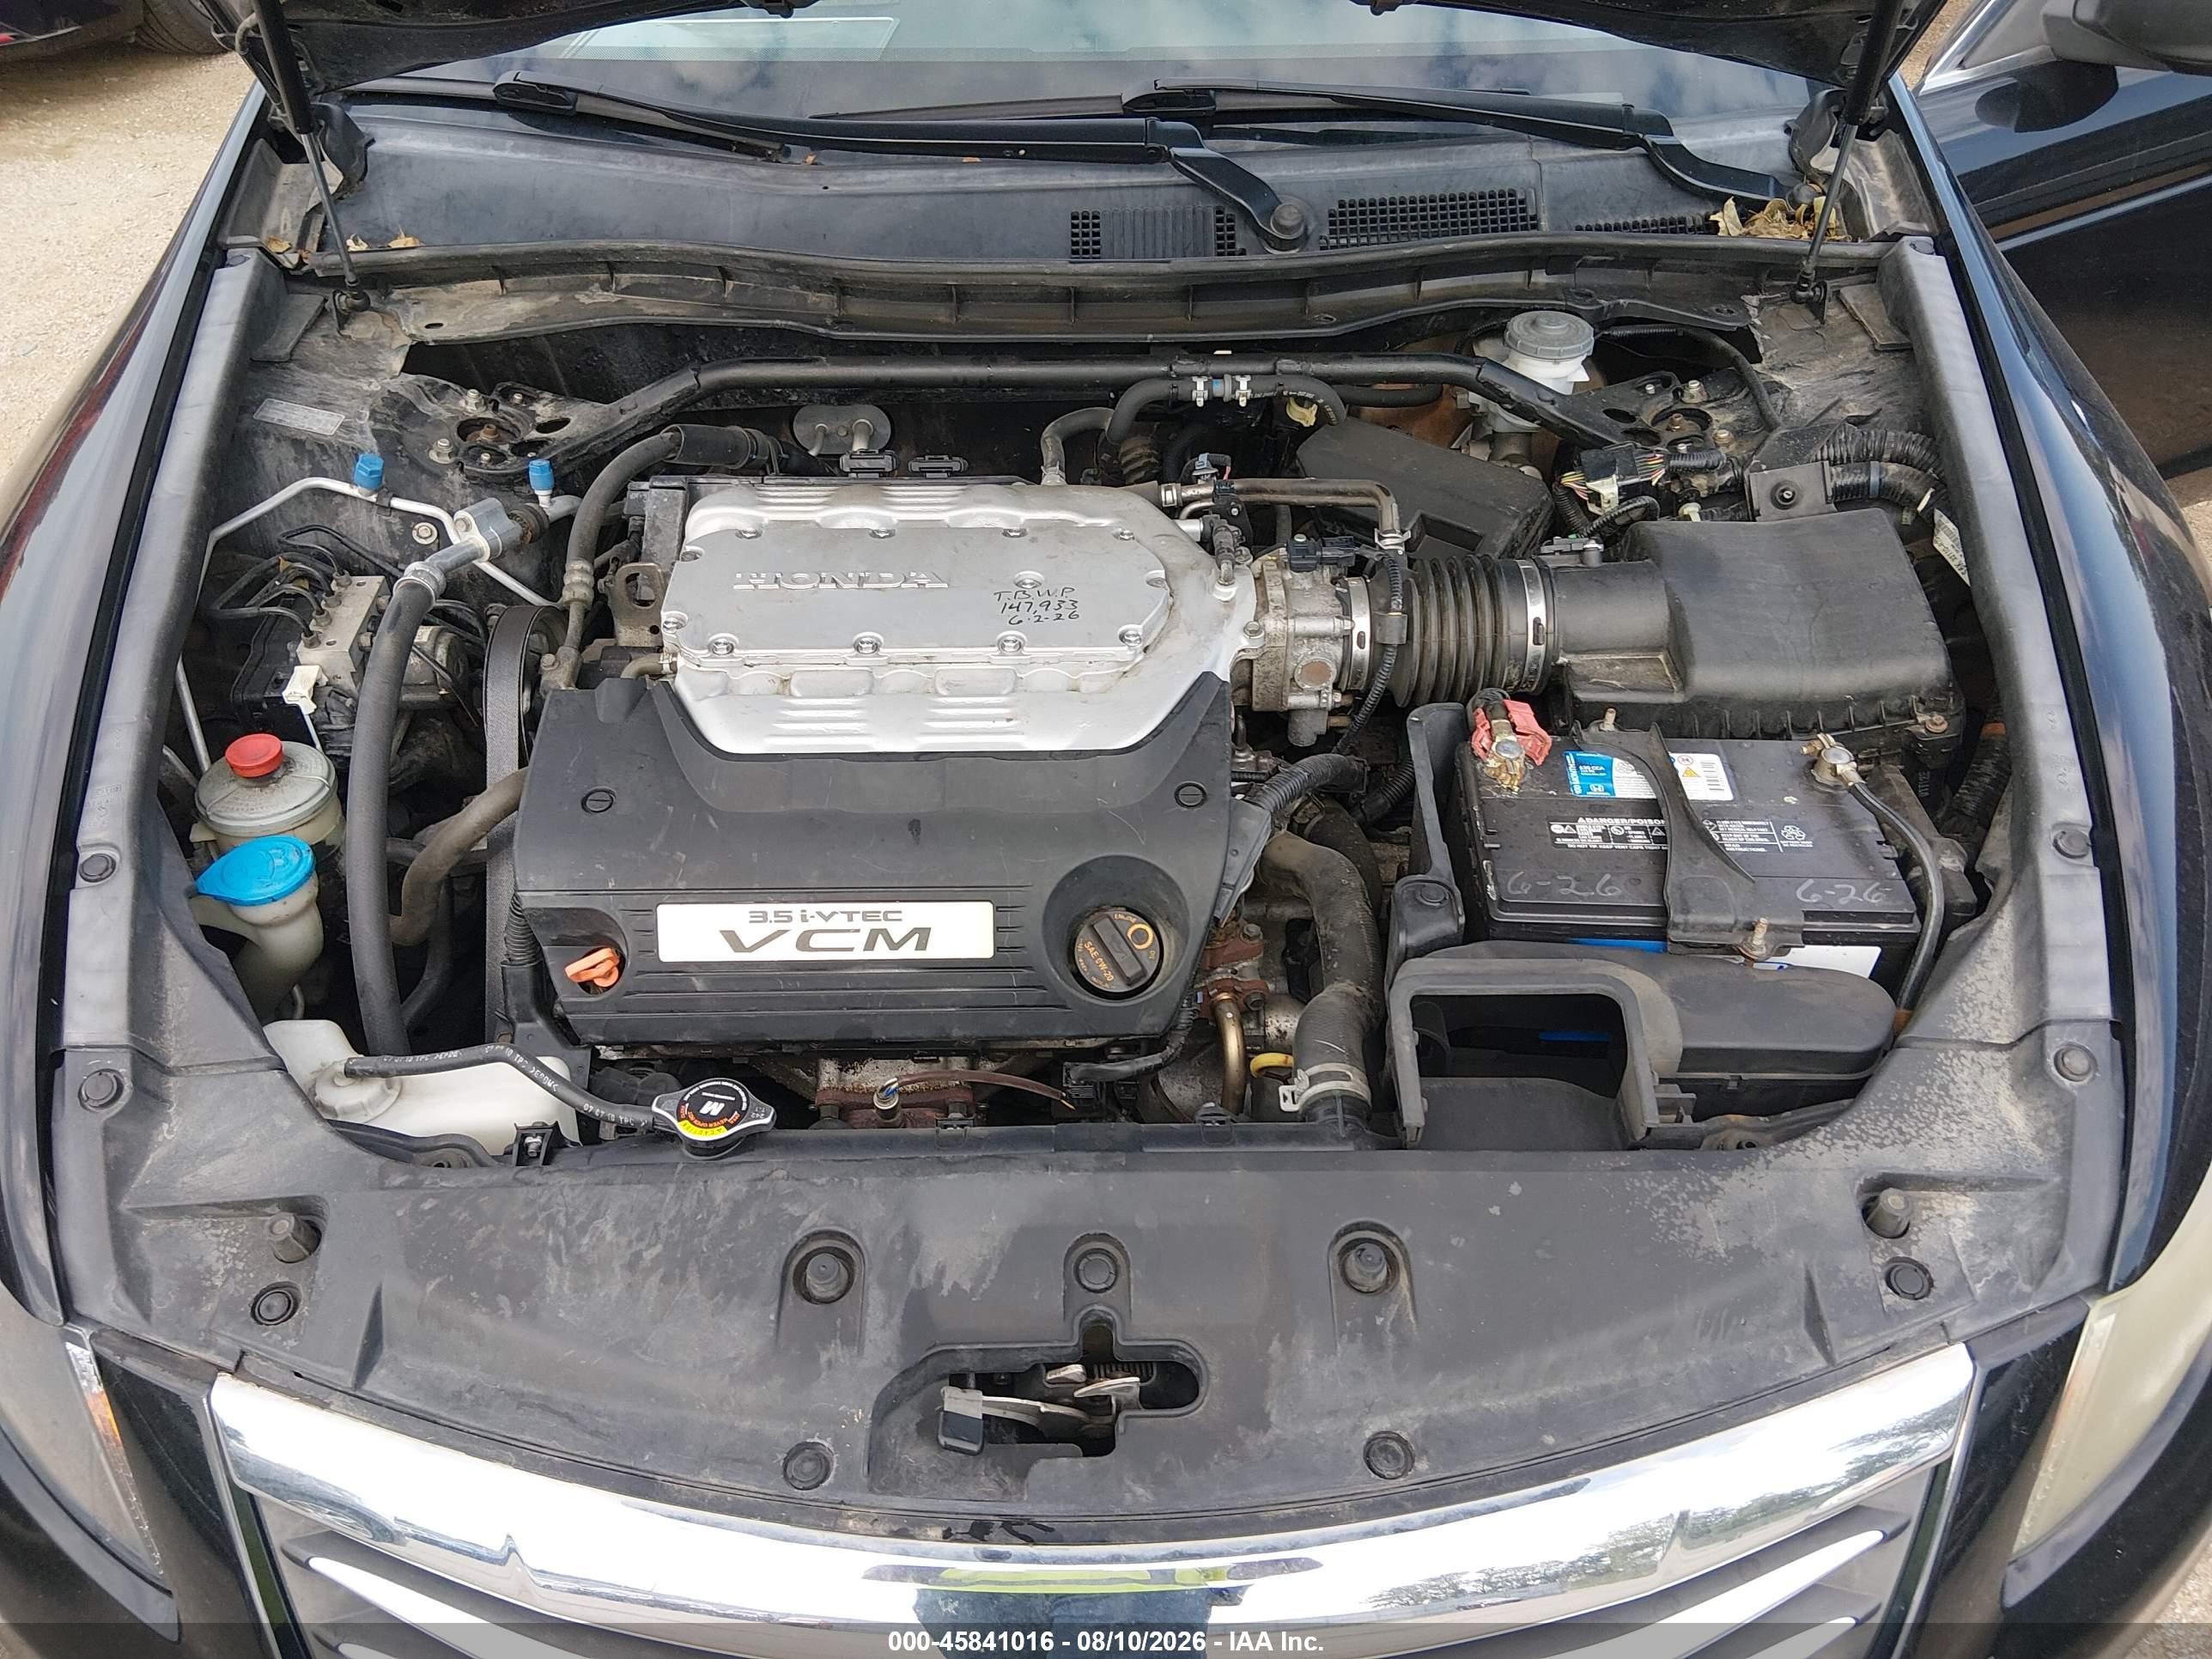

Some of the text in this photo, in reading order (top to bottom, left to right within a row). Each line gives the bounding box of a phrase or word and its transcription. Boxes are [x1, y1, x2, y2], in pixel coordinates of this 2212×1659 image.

[733, 572, 949, 590] HONDA
[1001, 599, 1079, 615] 147,933
[1507, 872, 1621, 897] 6-26
[1796, 878, 1892, 904] 6-26
[748, 908, 902, 924] 3.5 i-VTEC
[719, 927, 932, 953] VCM
[1084, 940, 1100, 959] SAE
[1095, 957, 1115, 981] 0W-20
